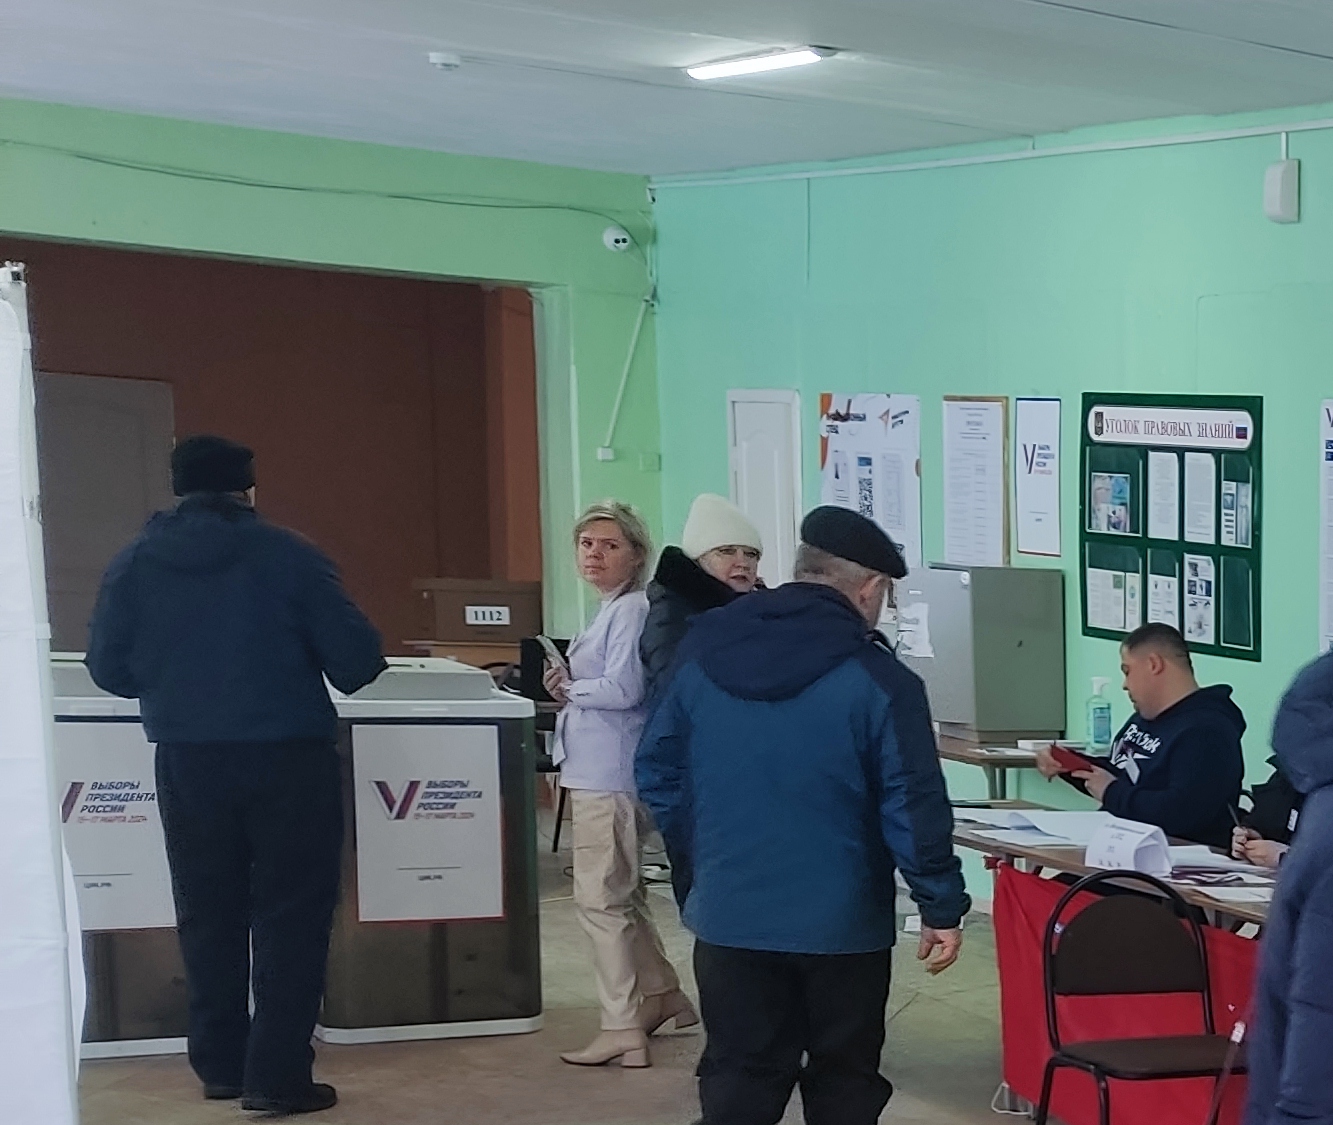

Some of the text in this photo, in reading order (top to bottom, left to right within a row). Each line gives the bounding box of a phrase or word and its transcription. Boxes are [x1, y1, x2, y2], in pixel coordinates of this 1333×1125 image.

[1104, 418, 1234, 439] УГОЛОК ПРАВОВЫХ ЗНАНИЙ
[474, 610, 503, 621] 1112
[90, 781, 141, 790] ВЫБОРЫ
[425, 780, 470, 789] ВЫБОРЫ
[85, 792, 157, 802] ПРЕЗИДЕНТА
[420, 790, 483, 800] ПРЕЗИДЕНТА
[80, 804, 127, 813] РОССИИ
[416, 802, 458, 811] РОССИИ
